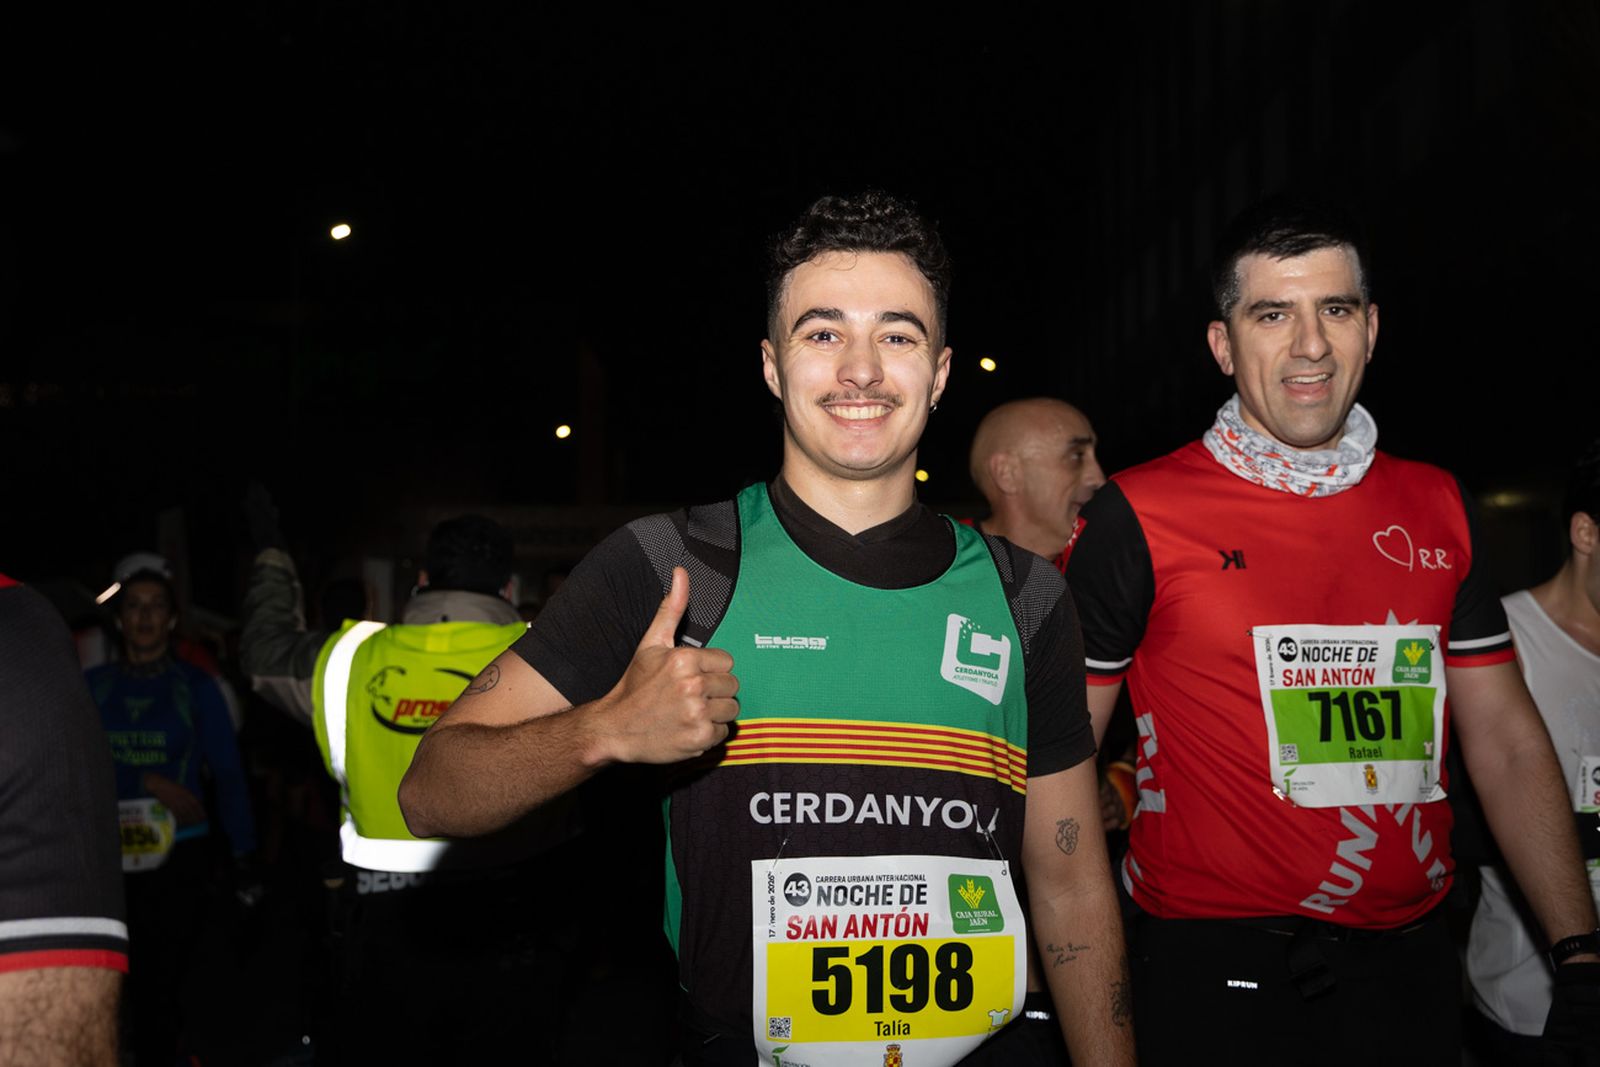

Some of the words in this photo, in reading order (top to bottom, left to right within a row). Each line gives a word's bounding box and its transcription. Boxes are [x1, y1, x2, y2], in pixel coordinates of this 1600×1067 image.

[1279, 642, 1297, 656] 43
[1301, 646, 1354, 663] NOCHE
[1356, 646, 1379, 663] DE
[954, 666, 999, 680] CERDANYOLA
[1282, 668, 1317, 687] SAN
[1321, 663, 1376, 686] ANTÓN
[1307, 690, 1402, 742] 7167
[1348, 746, 1383, 759] Rafael
[815, 875, 847, 883] CARRERA
[847, 875, 875, 883] URBANA
[876, 874, 926, 882] INTERNACIONAL
[784, 881, 810, 897] 43
[816, 884, 894, 907] NOCHE
[899, 883, 928, 905] DE
[786, 914, 838, 940] SAN
[842, 906, 929, 938] ANTÓN
[768, 928, 776, 938] 17
[811, 942, 975, 1016] 5198
[874, 1020, 911, 1037] Talía
